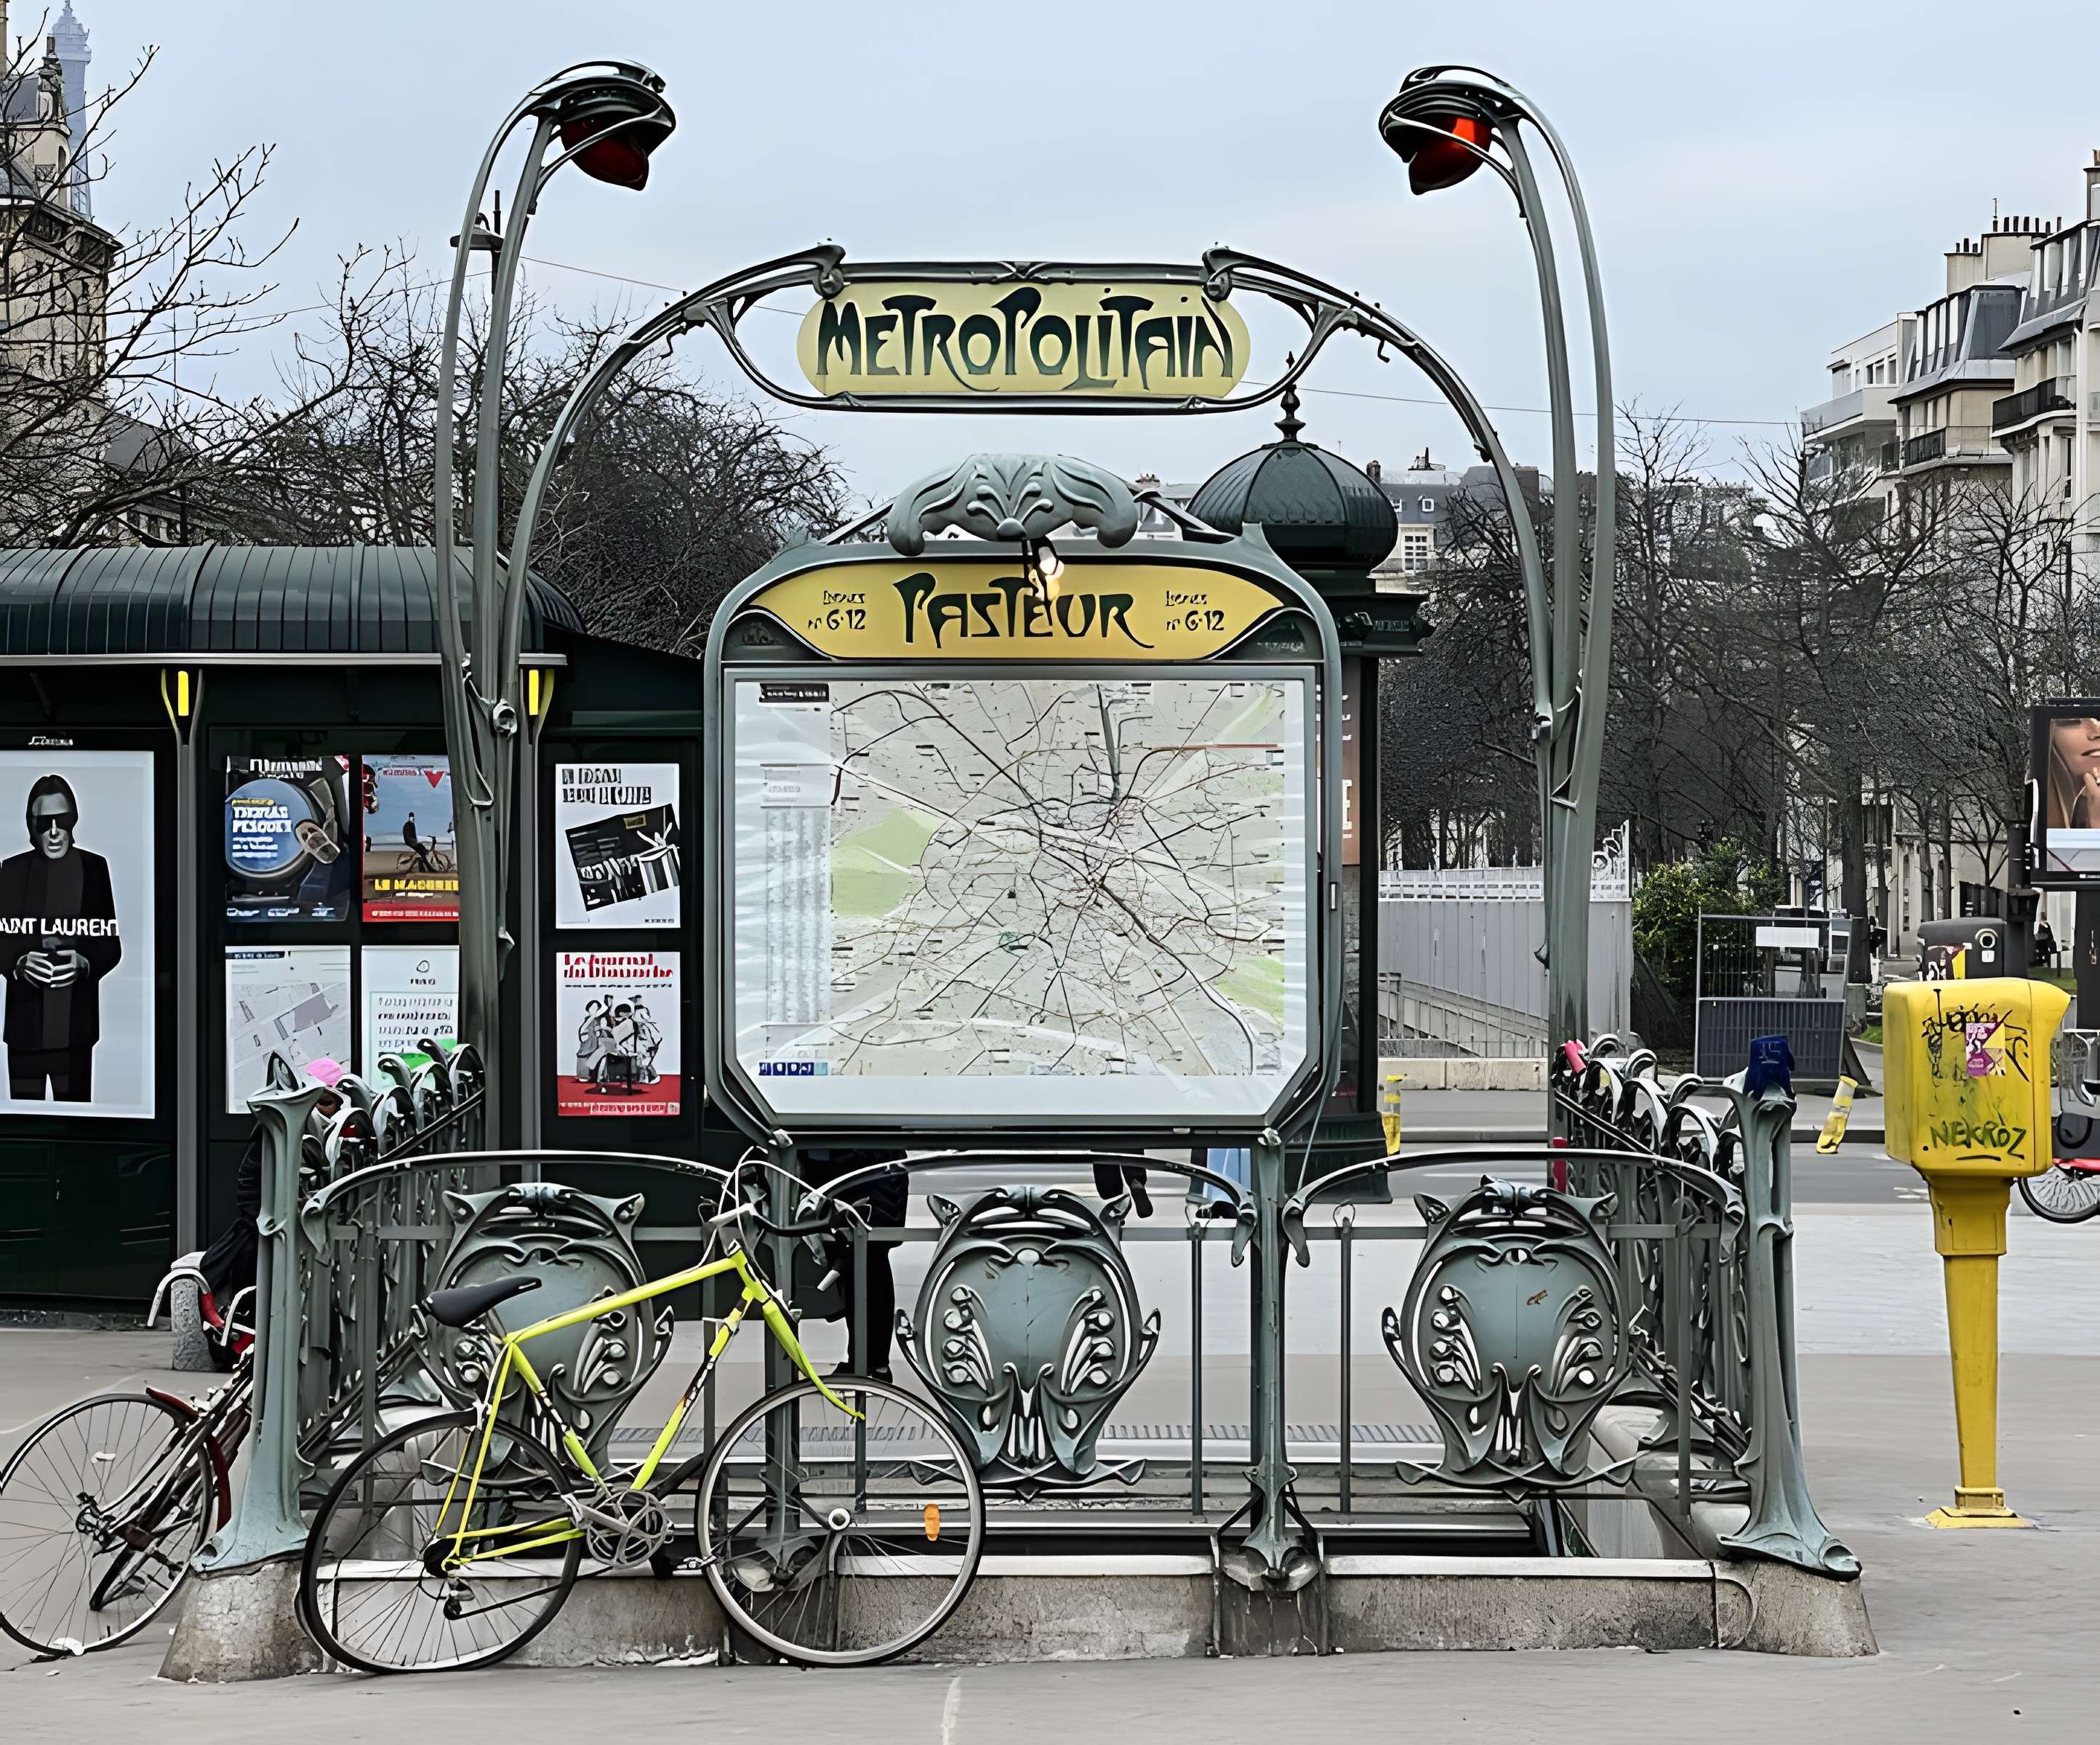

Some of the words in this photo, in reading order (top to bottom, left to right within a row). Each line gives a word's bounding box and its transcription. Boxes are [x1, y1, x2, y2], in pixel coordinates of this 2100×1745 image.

[816, 286, 1234, 392] METROPOLITAIN
[892, 572, 1155, 649] PASTEUR
[41, 918, 119, 936] LAURENT
